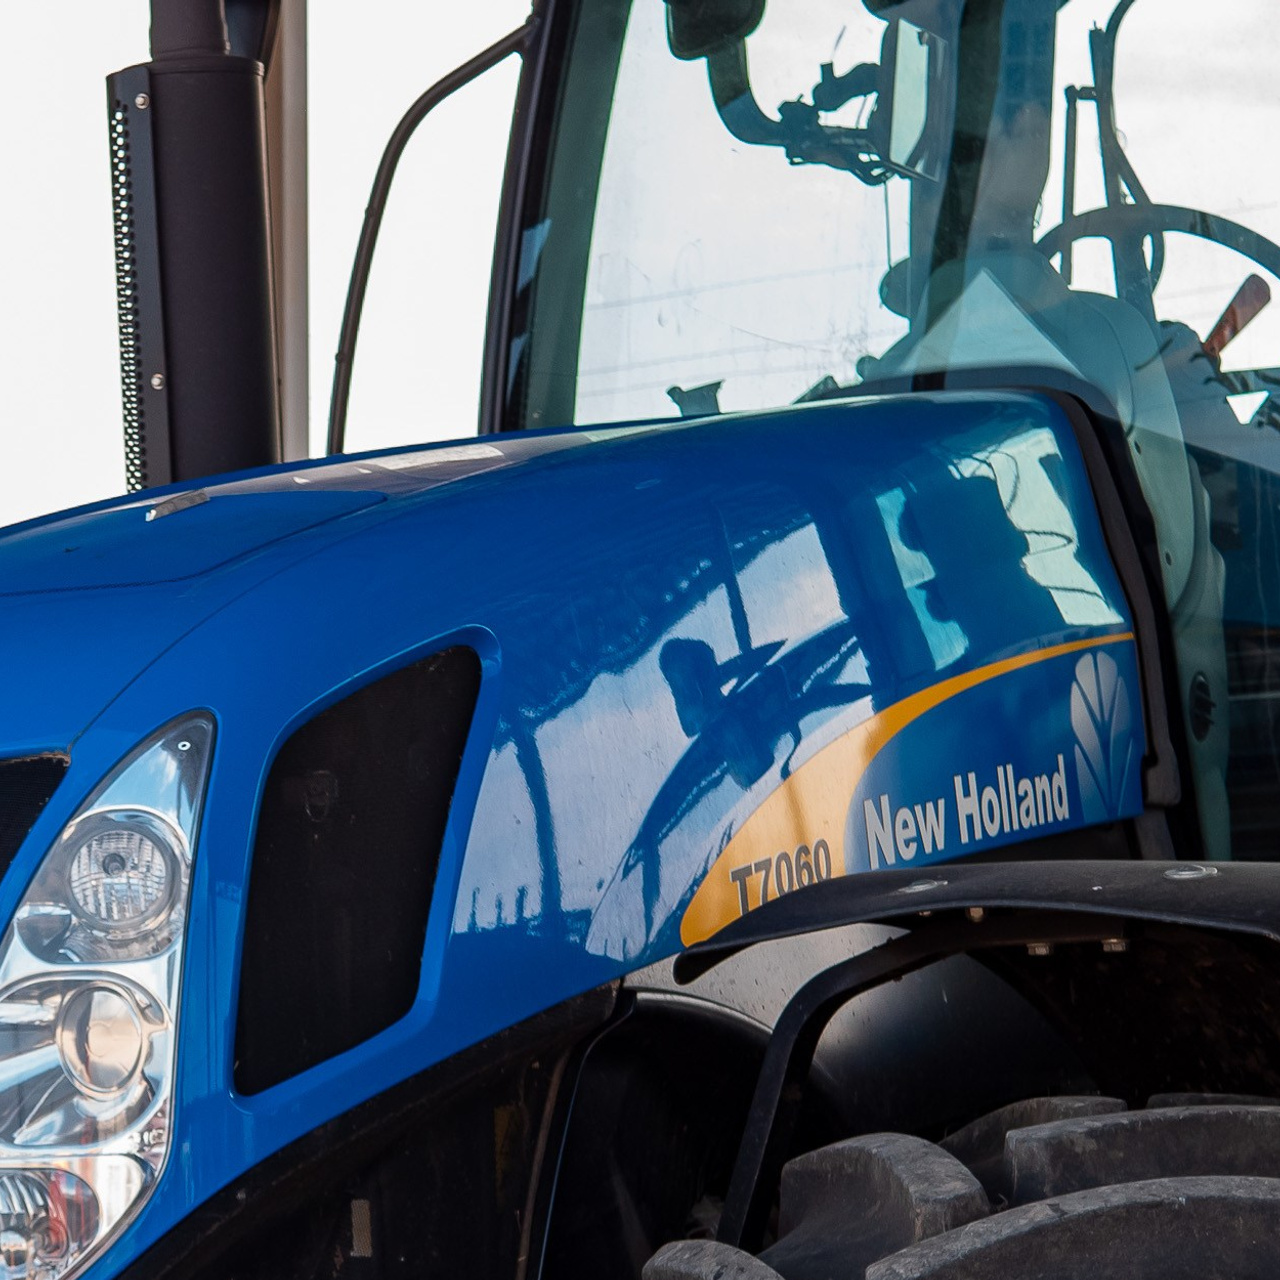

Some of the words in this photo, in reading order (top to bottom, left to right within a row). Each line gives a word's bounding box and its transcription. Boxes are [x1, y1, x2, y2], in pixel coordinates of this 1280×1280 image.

[863, 793, 946, 871] New
[953, 753, 1071, 845] Holland
[730, 838, 832, 917] T7060
